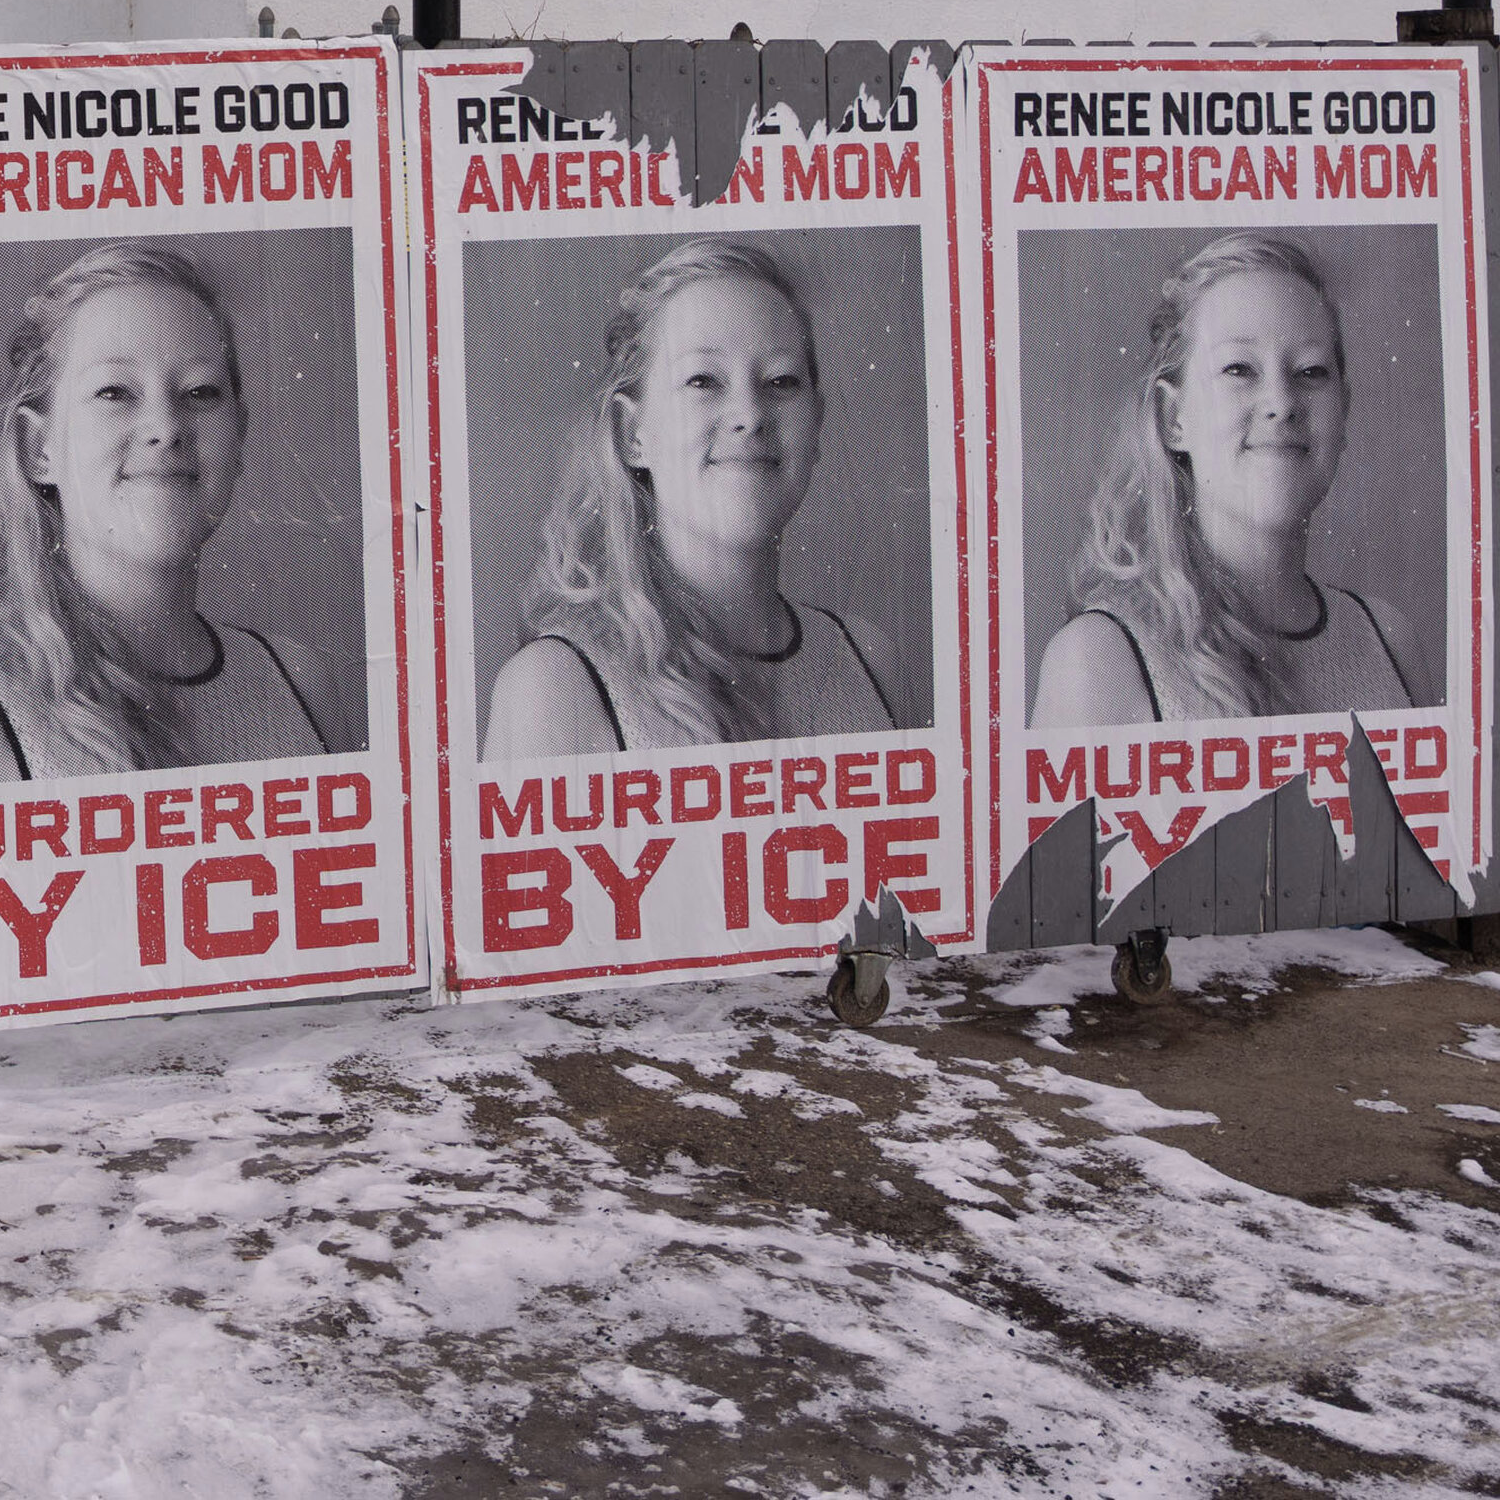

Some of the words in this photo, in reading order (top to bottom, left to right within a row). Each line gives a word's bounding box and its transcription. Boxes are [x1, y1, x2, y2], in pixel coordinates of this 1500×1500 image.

[24, 87, 200, 140] NICOLE
[214, 82, 350, 133] GOOD
[1014, 92, 1151, 137] RENEE
[1163, 92, 1312, 136] NICOLE
[1324, 91, 1435, 135] GOOD
[202, 139, 353, 205] MOM
[457, 146, 765, 214] AMERICN
[783, 141, 921, 202] MOM
[1013, 145, 1297, 204] AMERICAN
[1315, 143, 1438, 200] MOM
[478, 747, 937, 840] MURDERED
[135, 843, 380, 967] ICE
[481, 837, 676, 953] BY
[722, 816, 942, 931] ICE
